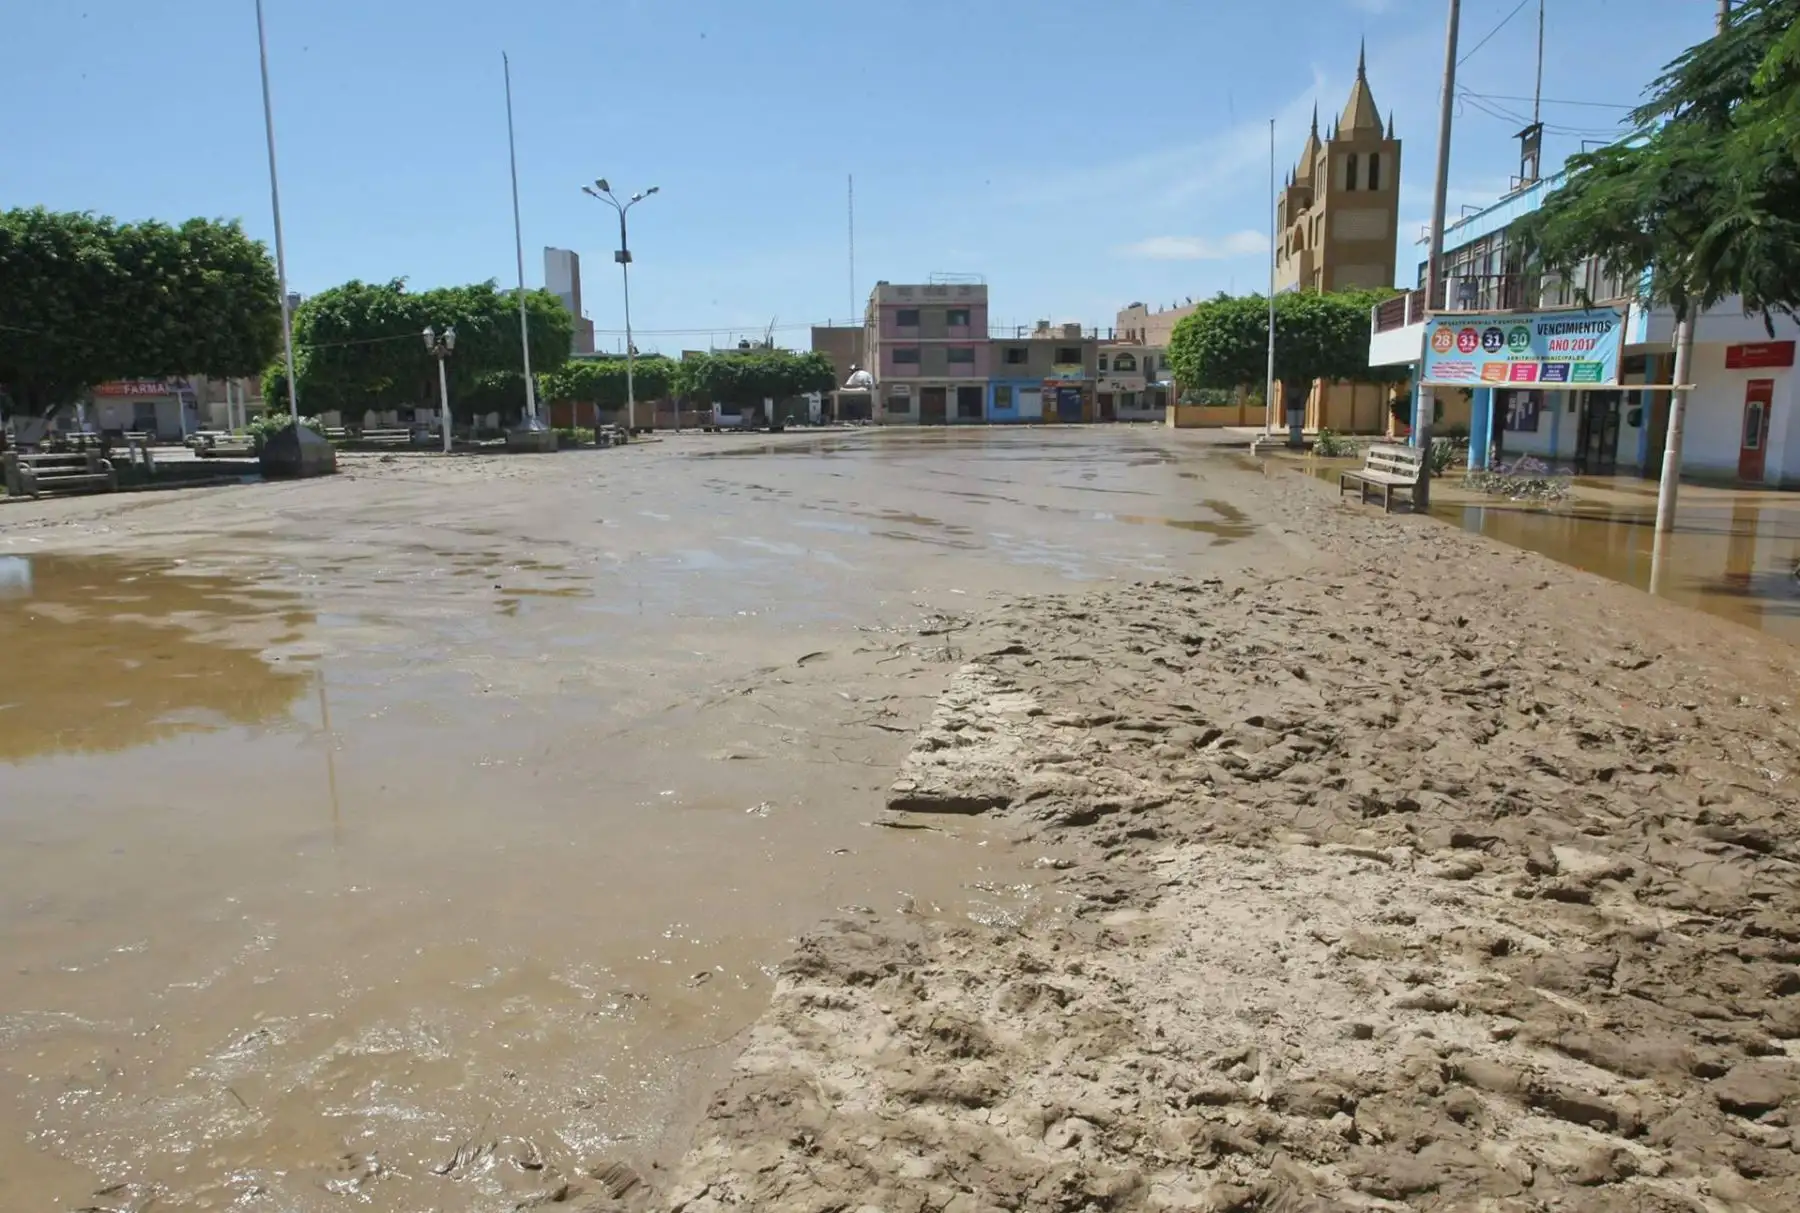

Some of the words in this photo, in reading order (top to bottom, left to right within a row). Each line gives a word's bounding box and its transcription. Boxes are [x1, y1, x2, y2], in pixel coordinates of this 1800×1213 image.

[1537, 320, 1612, 336] VENCIMIENTOS
[1435, 335, 1450, 347] 28
[1459, 335, 1475, 347] 31
[1484, 334, 1501, 347] 31
[1510, 333, 1527, 347] 30
[1572, 338, 1596, 351] 2017
[123, 383, 165, 395] FARMA
